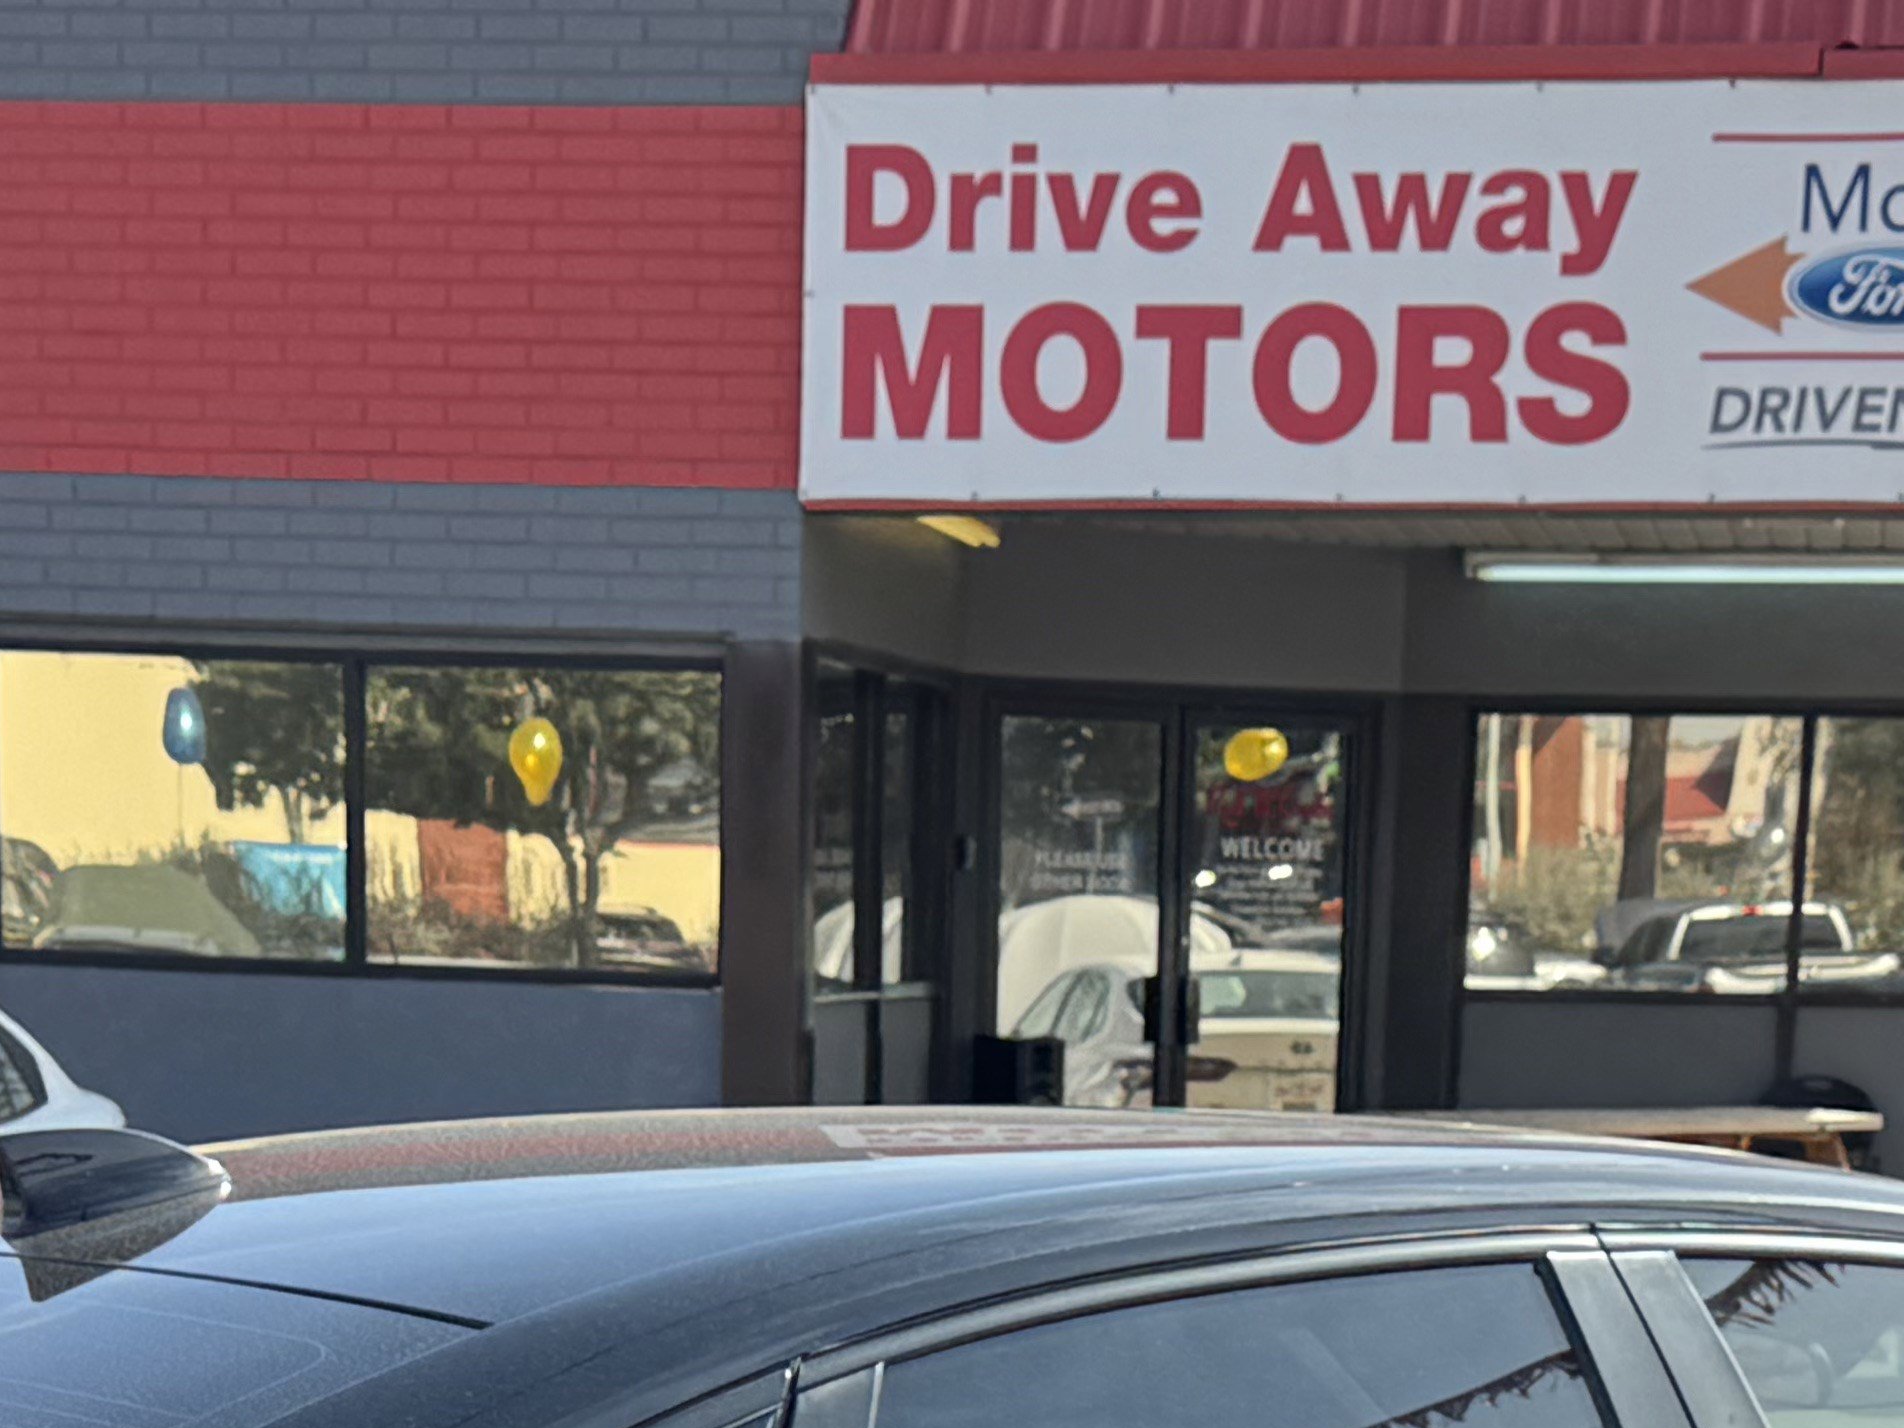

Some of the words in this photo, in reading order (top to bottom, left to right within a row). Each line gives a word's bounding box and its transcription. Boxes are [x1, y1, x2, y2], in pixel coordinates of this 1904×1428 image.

[843, 142, 1203, 254] Drive
[1251, 142, 1640, 277] Away
[839, 300, 1632, 447] MOTORS
[1221, 836, 1325, 860] WELCOME
